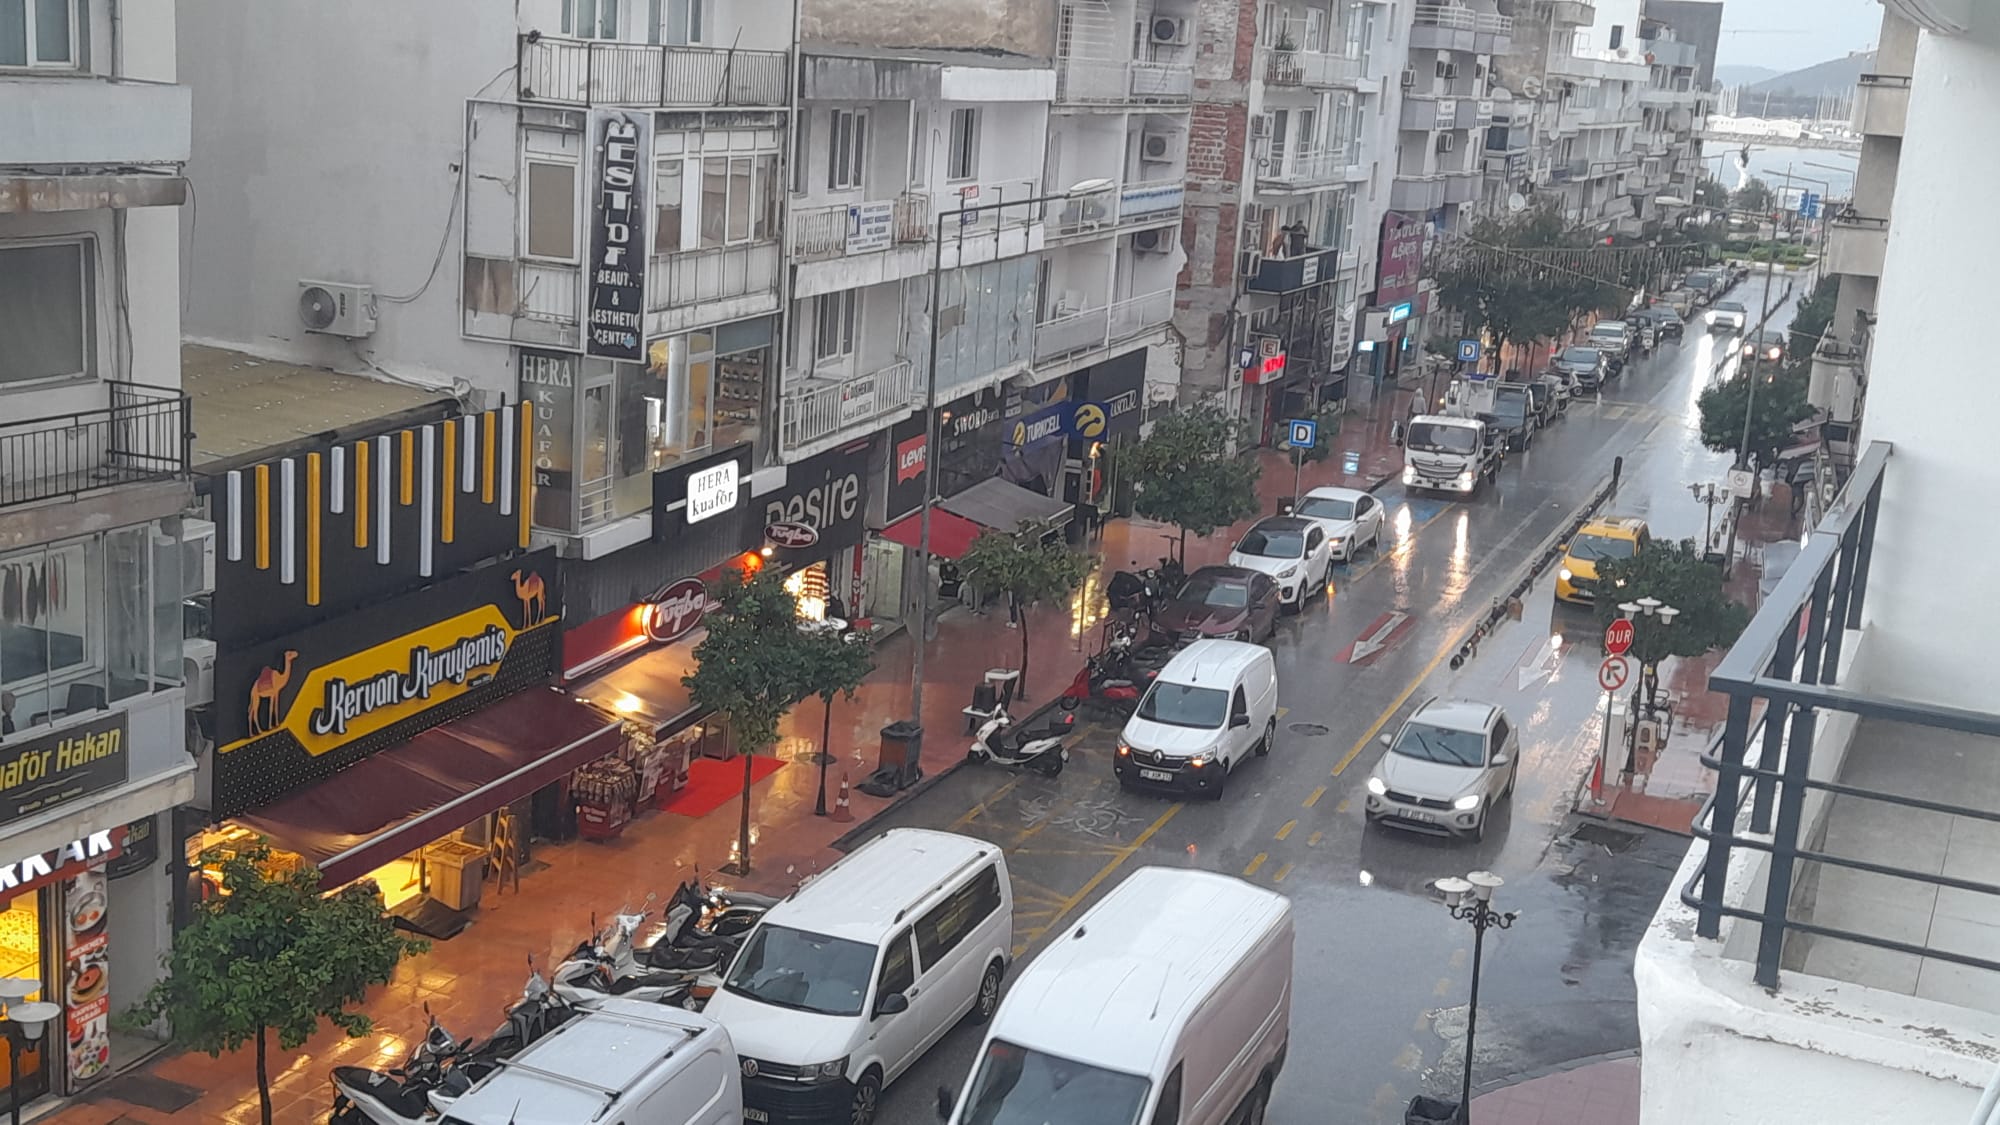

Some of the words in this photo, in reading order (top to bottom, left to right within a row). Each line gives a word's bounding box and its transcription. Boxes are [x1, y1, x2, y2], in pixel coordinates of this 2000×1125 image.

[612, 291, 619, 305] &
[1464, 345, 1473, 356] D
[521, 354, 572, 387] HERA
[536, 391, 553, 486] KUAFÖR
[1296, 426, 1308, 442] D
[698, 468, 731, 493] HERA
[692, 489, 734, 516] kuaför
[1608, 629, 1632, 645] DUR
[316, 672, 398, 734] Kervan
[56, 728, 121, 772] Hakan
